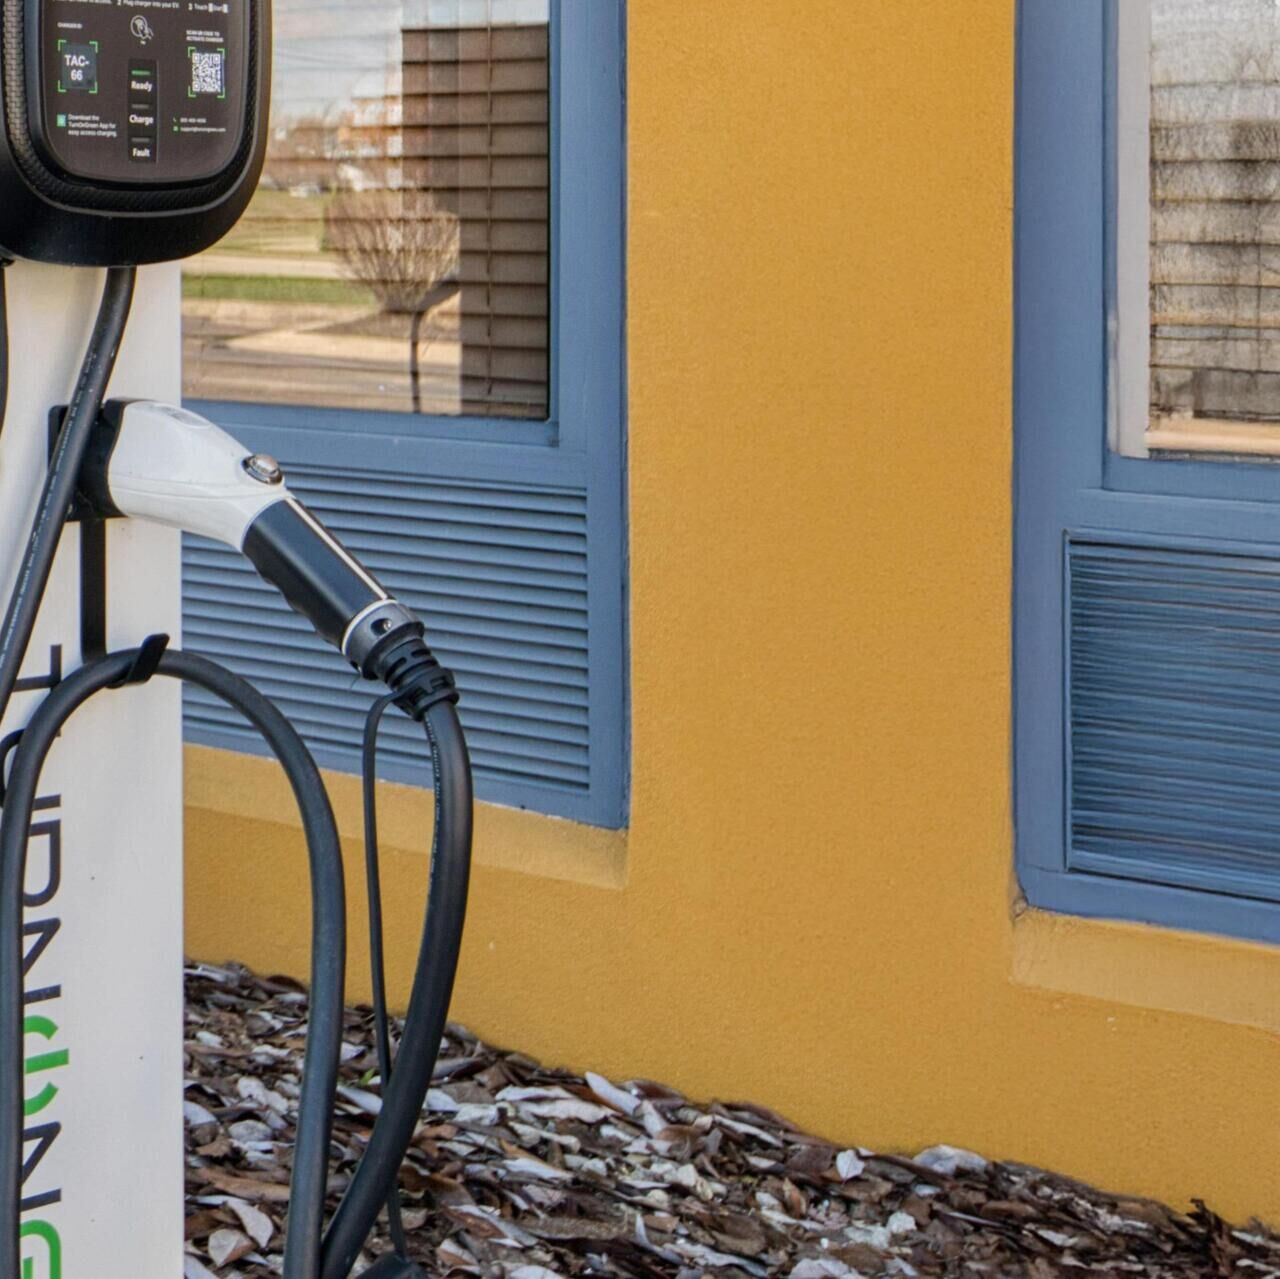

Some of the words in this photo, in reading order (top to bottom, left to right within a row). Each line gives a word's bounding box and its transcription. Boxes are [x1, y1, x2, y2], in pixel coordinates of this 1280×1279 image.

[64, 54, 90, 67] TAC-
[70, 69, 83, 81] 66
[130, 80, 152, 92] Ready
[129, 114, 154, 126] Charge
[132, 147, 150, 158] Fault
